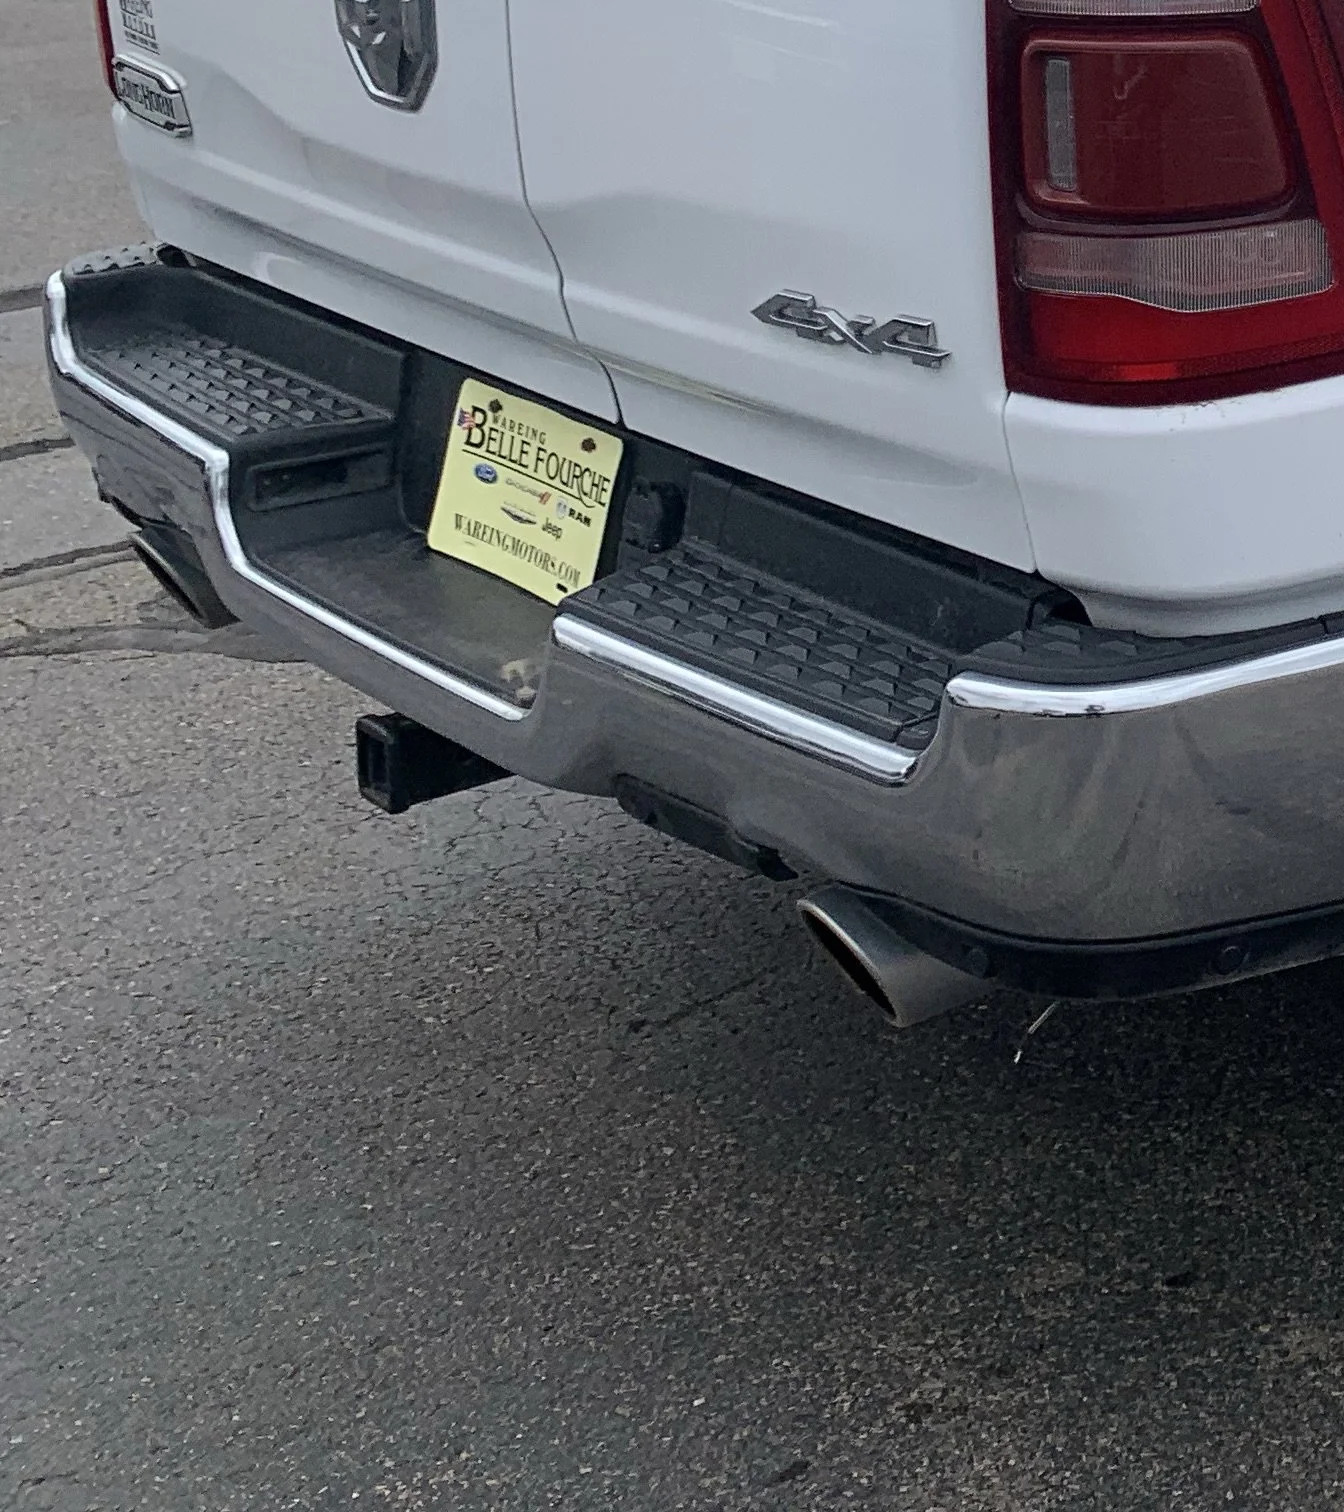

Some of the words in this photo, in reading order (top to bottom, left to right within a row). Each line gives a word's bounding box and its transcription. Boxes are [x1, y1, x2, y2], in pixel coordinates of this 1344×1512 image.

[491, 413, 547, 446] WAREING
[464, 405, 530, 470] BELLE
[534, 446, 611, 508] FOURCHE
[568, 507, 592, 528] RAM
